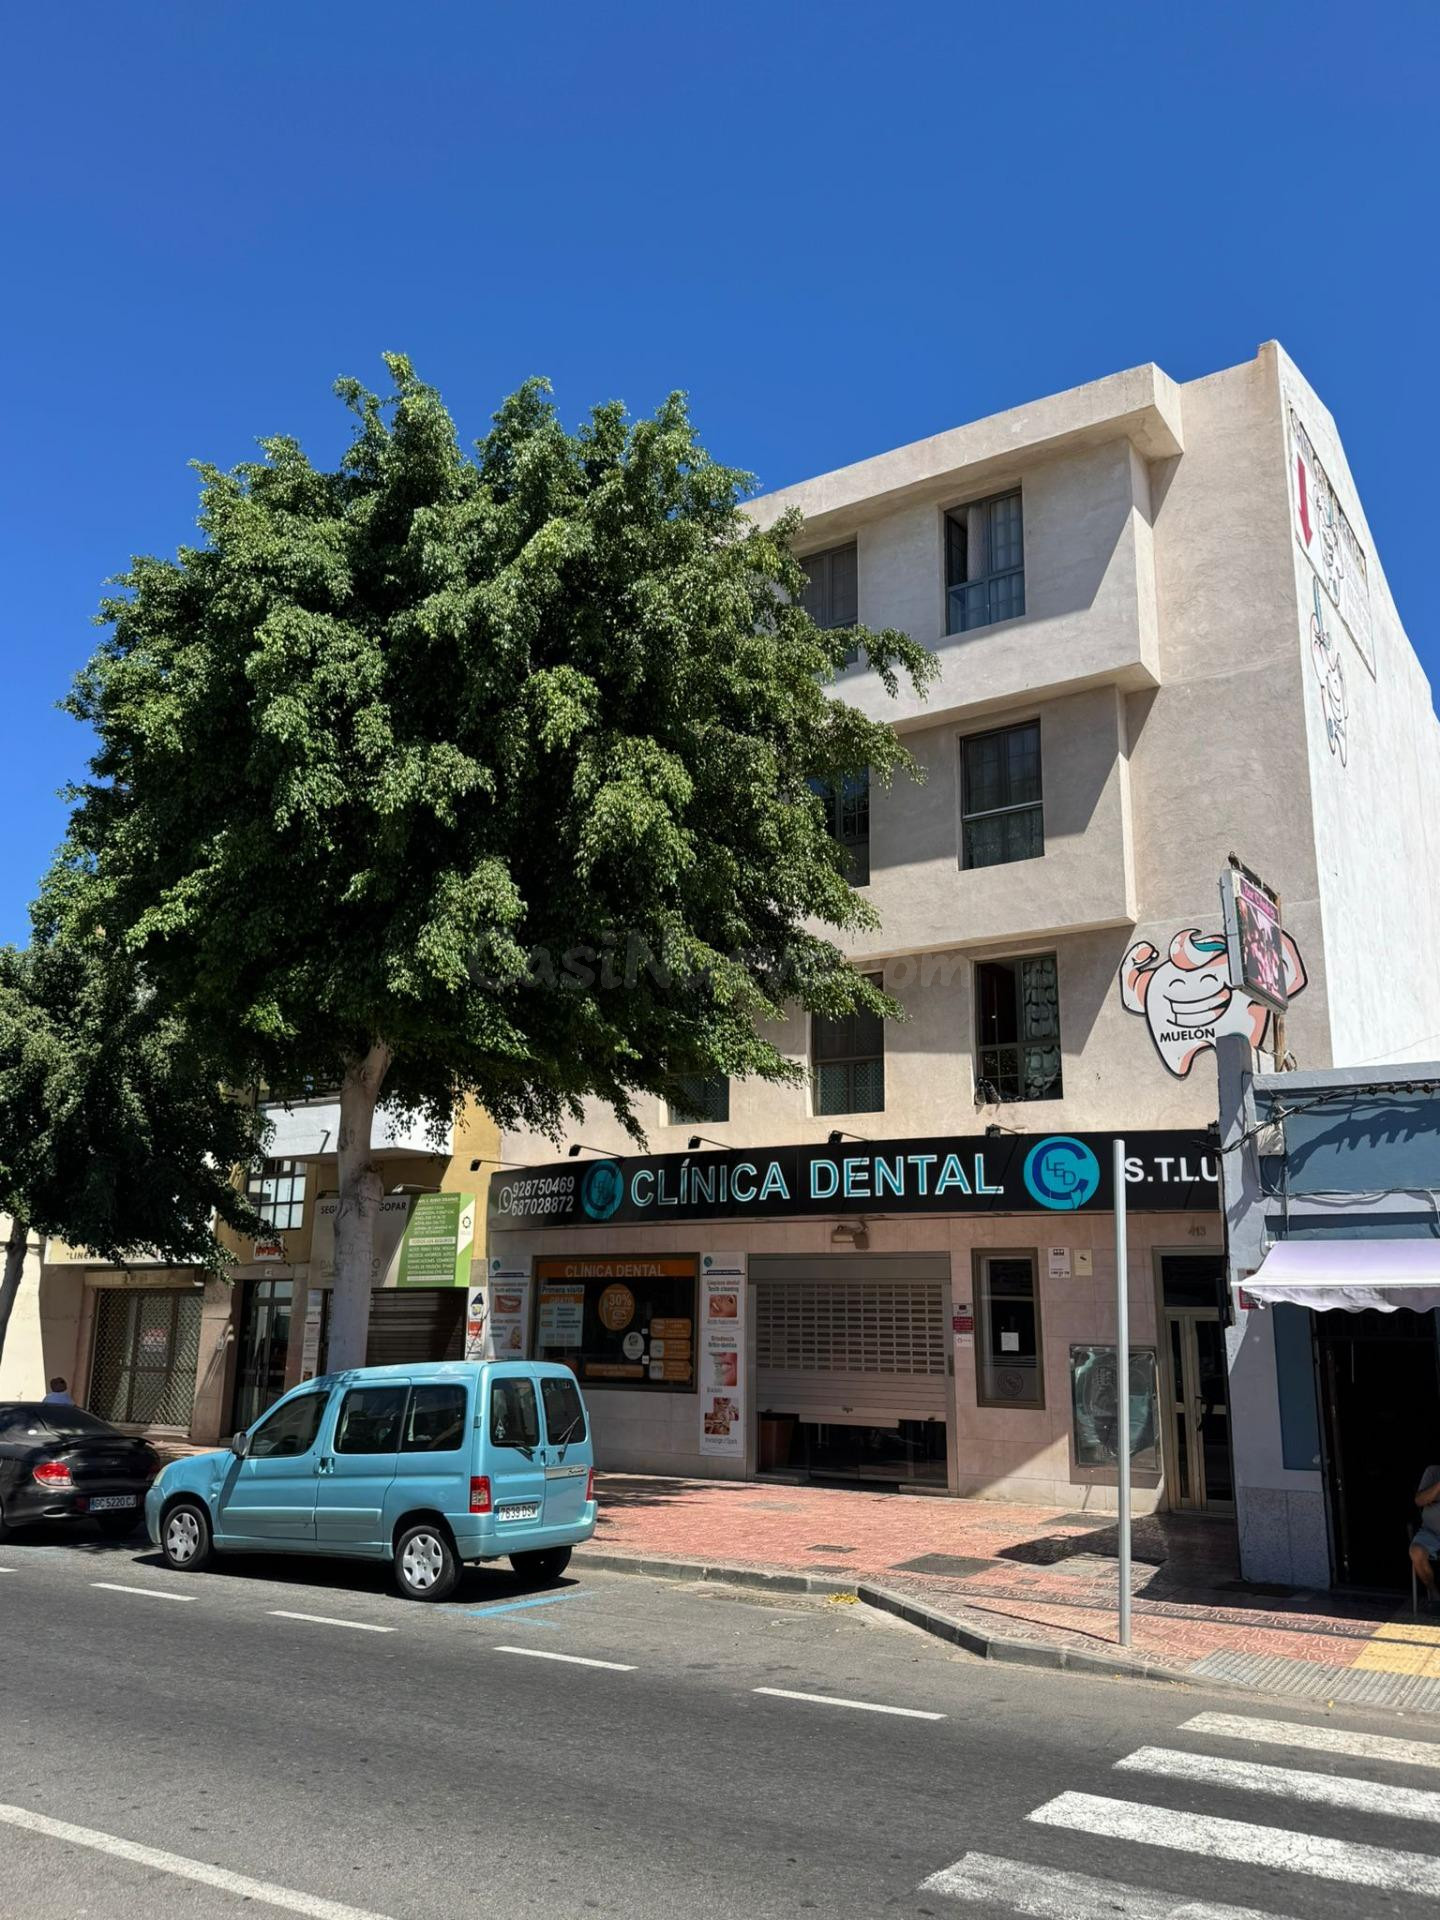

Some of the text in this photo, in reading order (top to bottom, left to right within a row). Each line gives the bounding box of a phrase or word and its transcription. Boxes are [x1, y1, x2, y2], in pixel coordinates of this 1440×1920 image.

[512, 1176, 575, 1197] 928750469
[631, 1158, 791, 1208] CLÍNICA
[810, 1153, 1004, 1199] DENTAL
[511, 1195, 574, 1216] 687028872
[564, 1263, 664, 1278] CLÍNICA DENTAL
[609, 1294, 632, 1307] 30%
